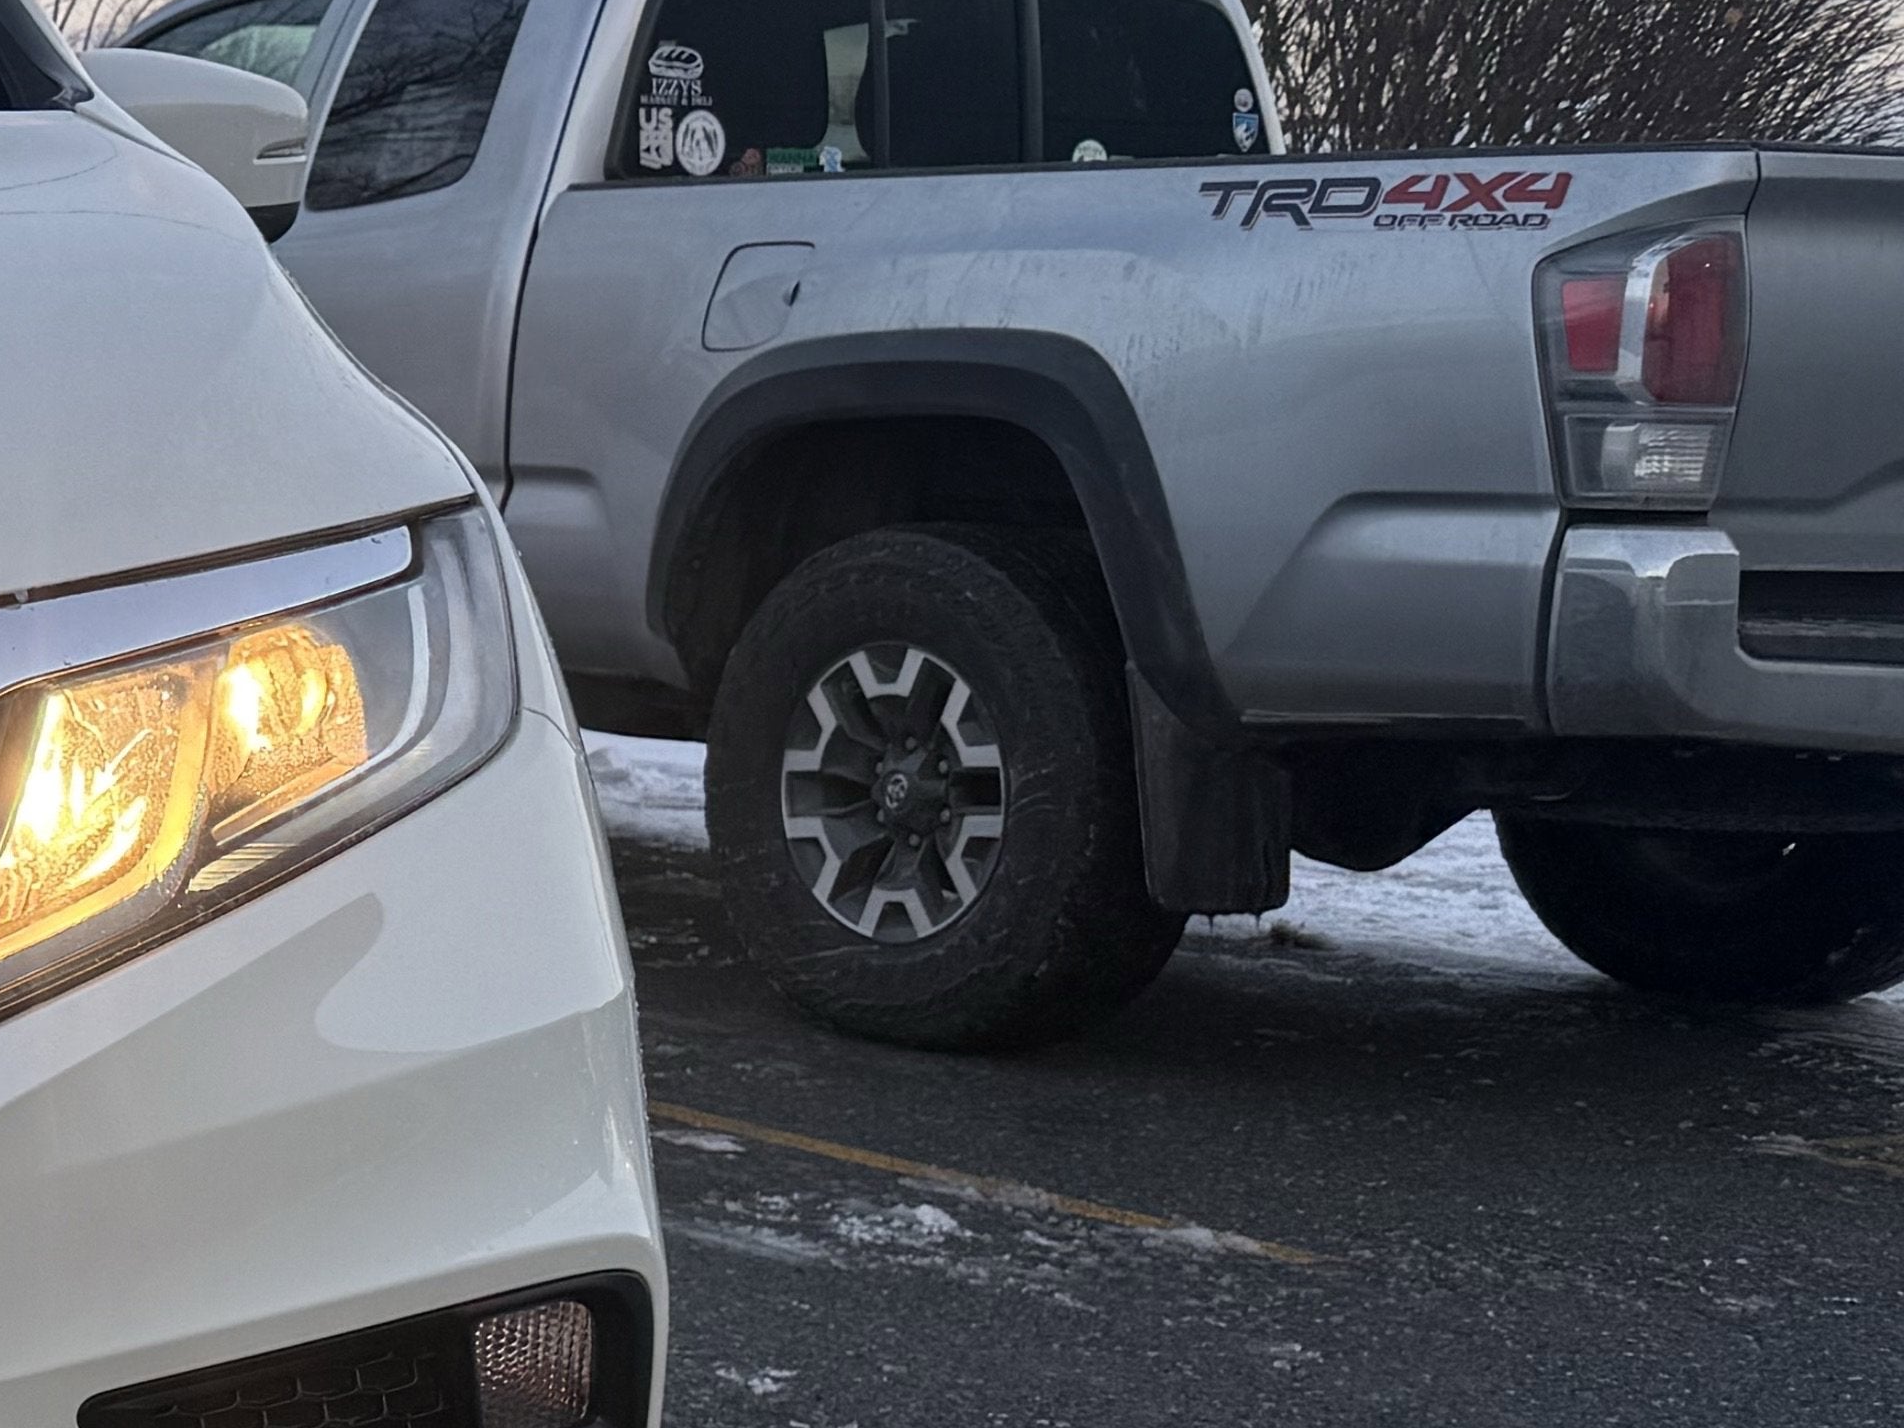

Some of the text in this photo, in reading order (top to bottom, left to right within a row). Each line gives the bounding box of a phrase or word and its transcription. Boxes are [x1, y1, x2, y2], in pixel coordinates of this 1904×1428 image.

[652, 77, 702, 96] IZZYS
[1198, 171, 1572, 231] TRD 4X4
[1373, 213, 1551, 231] OFF ROAD
